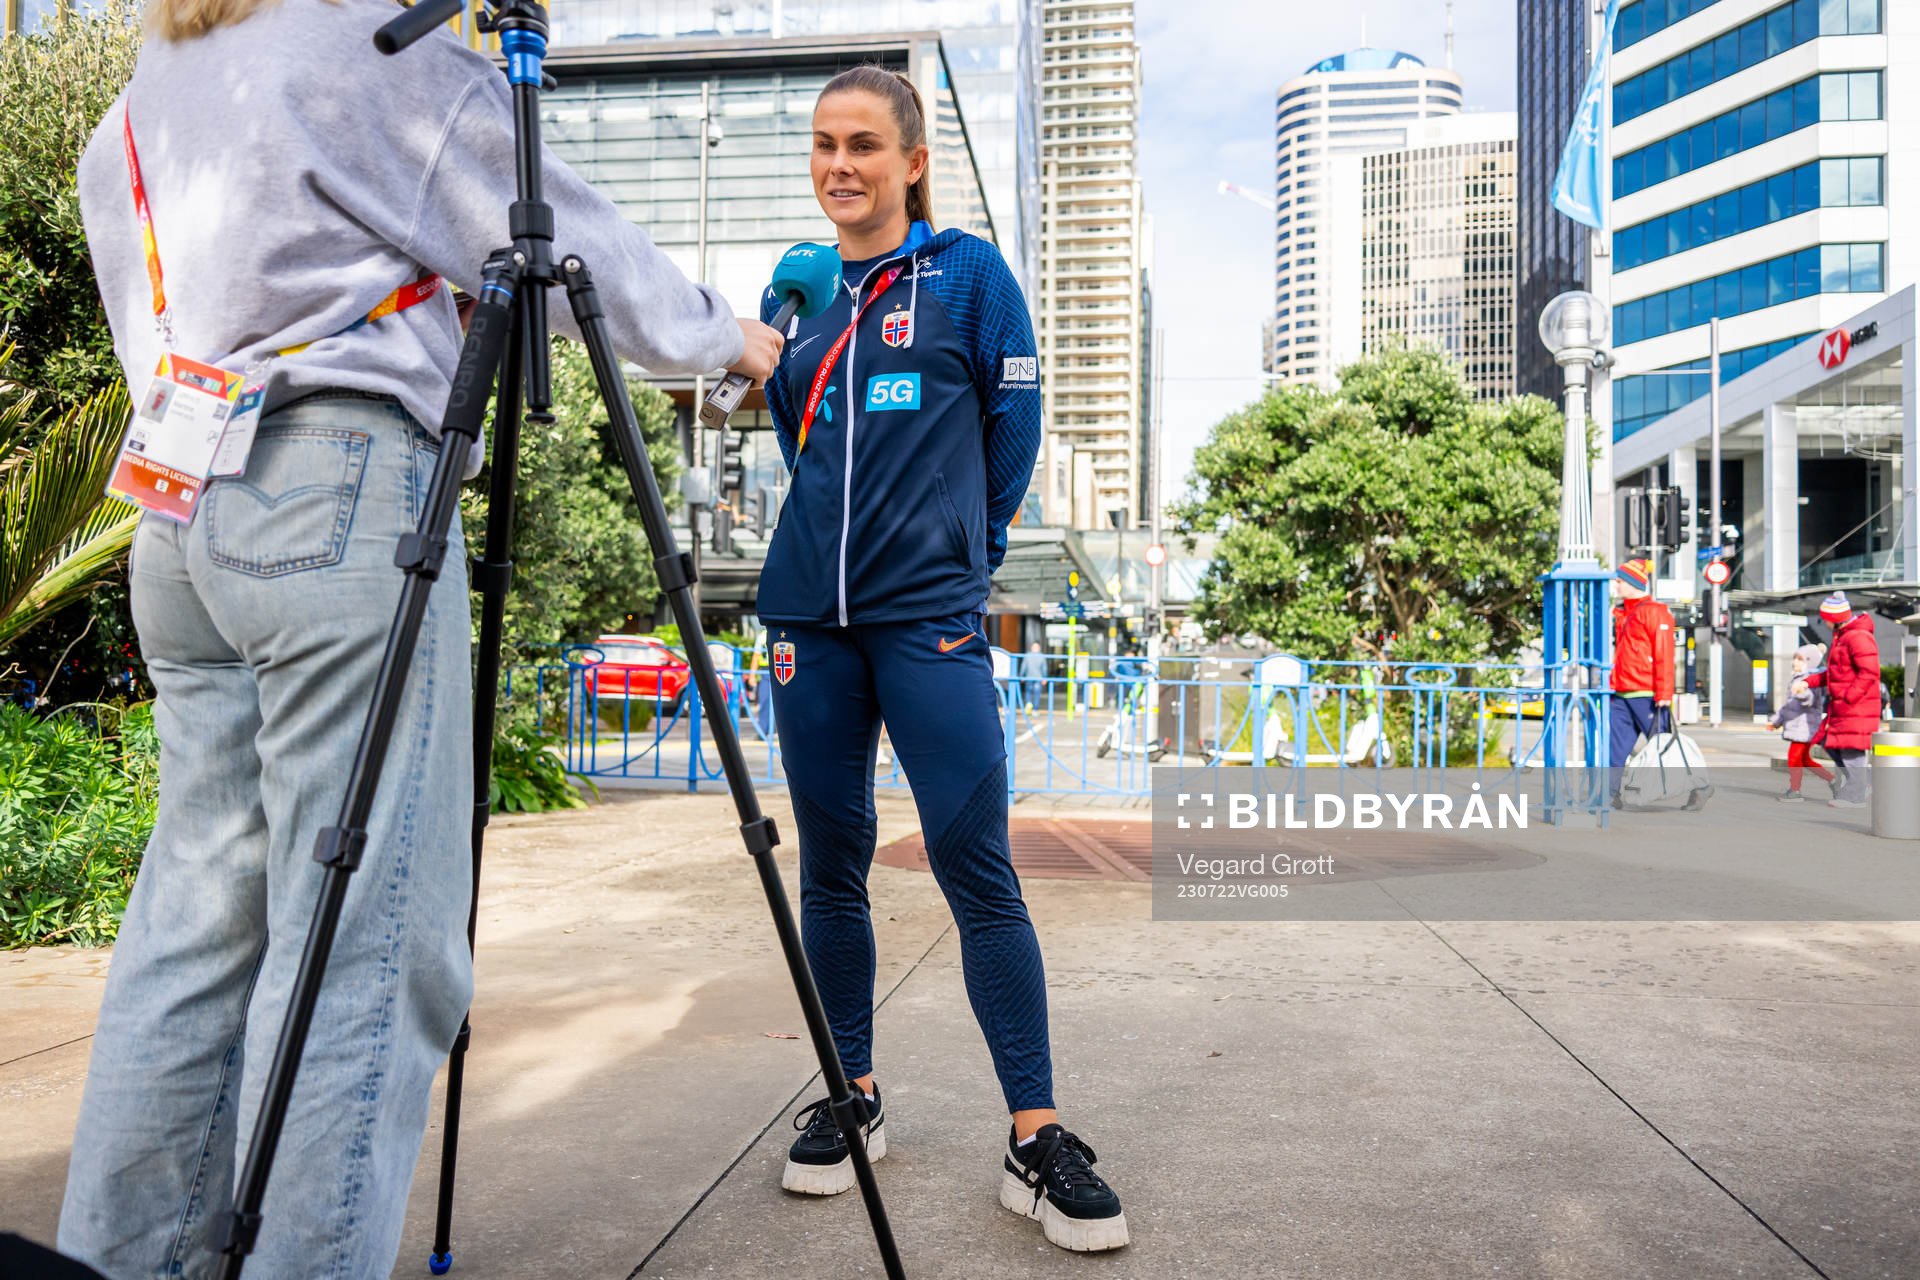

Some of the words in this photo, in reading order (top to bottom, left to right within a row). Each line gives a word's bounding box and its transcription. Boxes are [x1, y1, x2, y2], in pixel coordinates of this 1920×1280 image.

[902, 273, 920, 281] Nork
[920, 269, 943, 278] Tipping
[450, 317, 487, 408] BENRO
[824, 354, 835, 369] CUP
[1008, 357, 1034, 380] DNB
[871, 380, 913, 404] 5G
[123, 452, 145, 467] MEDIA
[145, 459, 170, 476] RIGHTS
[169, 470, 201, 488] LICENSEE
